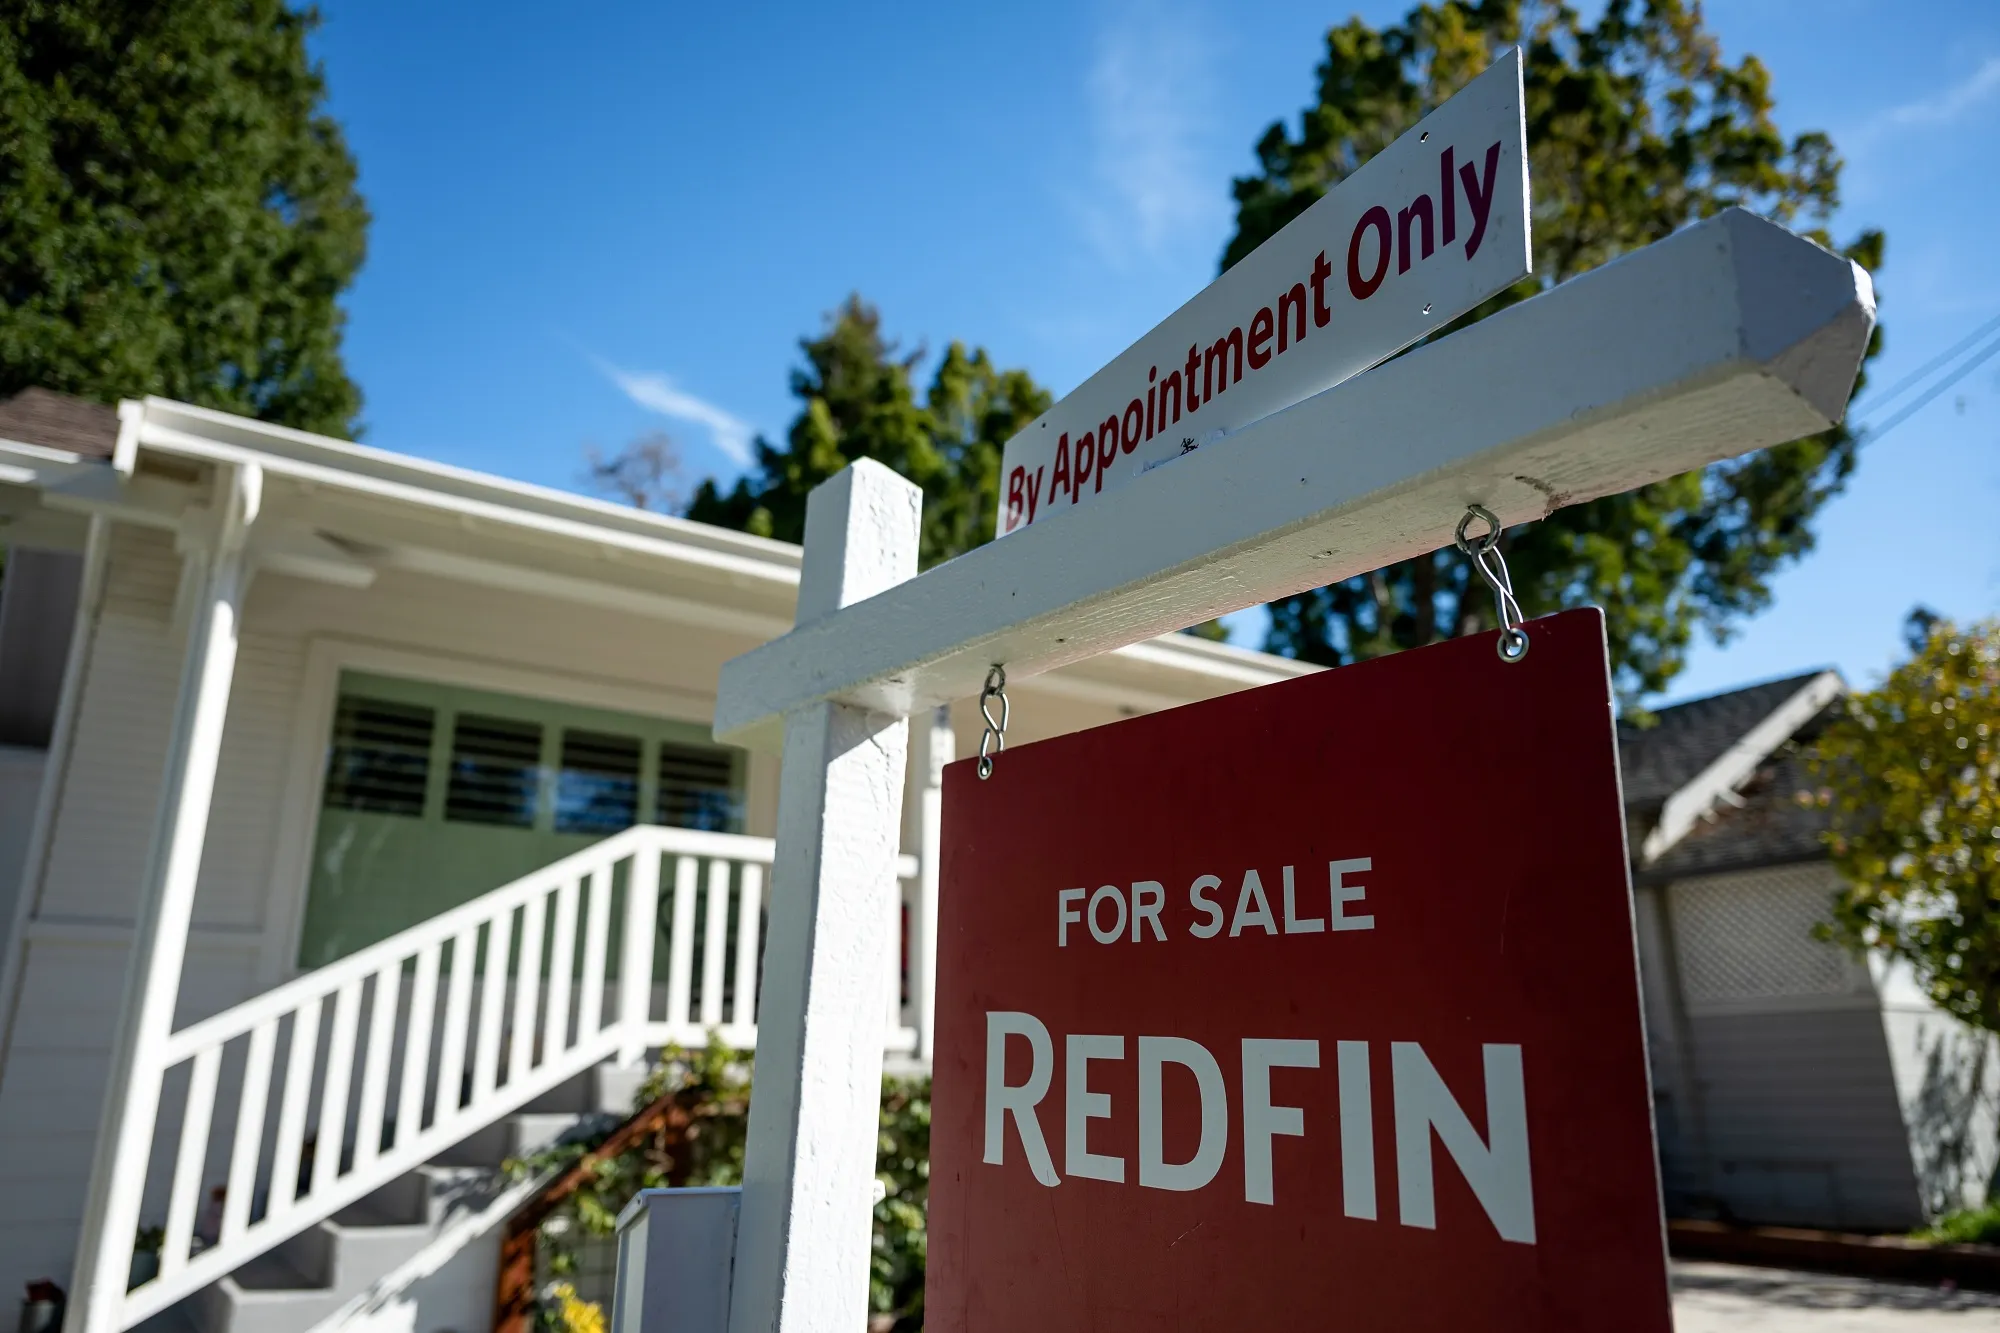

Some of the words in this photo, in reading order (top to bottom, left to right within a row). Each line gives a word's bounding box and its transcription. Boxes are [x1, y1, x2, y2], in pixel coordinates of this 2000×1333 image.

[1005, 465, 1044, 531] By
[1048, 250, 1331, 503] Appointment
[1347, 140, 1501, 300] Only
[1058, 881, 1168, 947] FOR
[1188, 857, 1375, 939] SALE
[982, 1011, 1537, 1245] REDFIN
